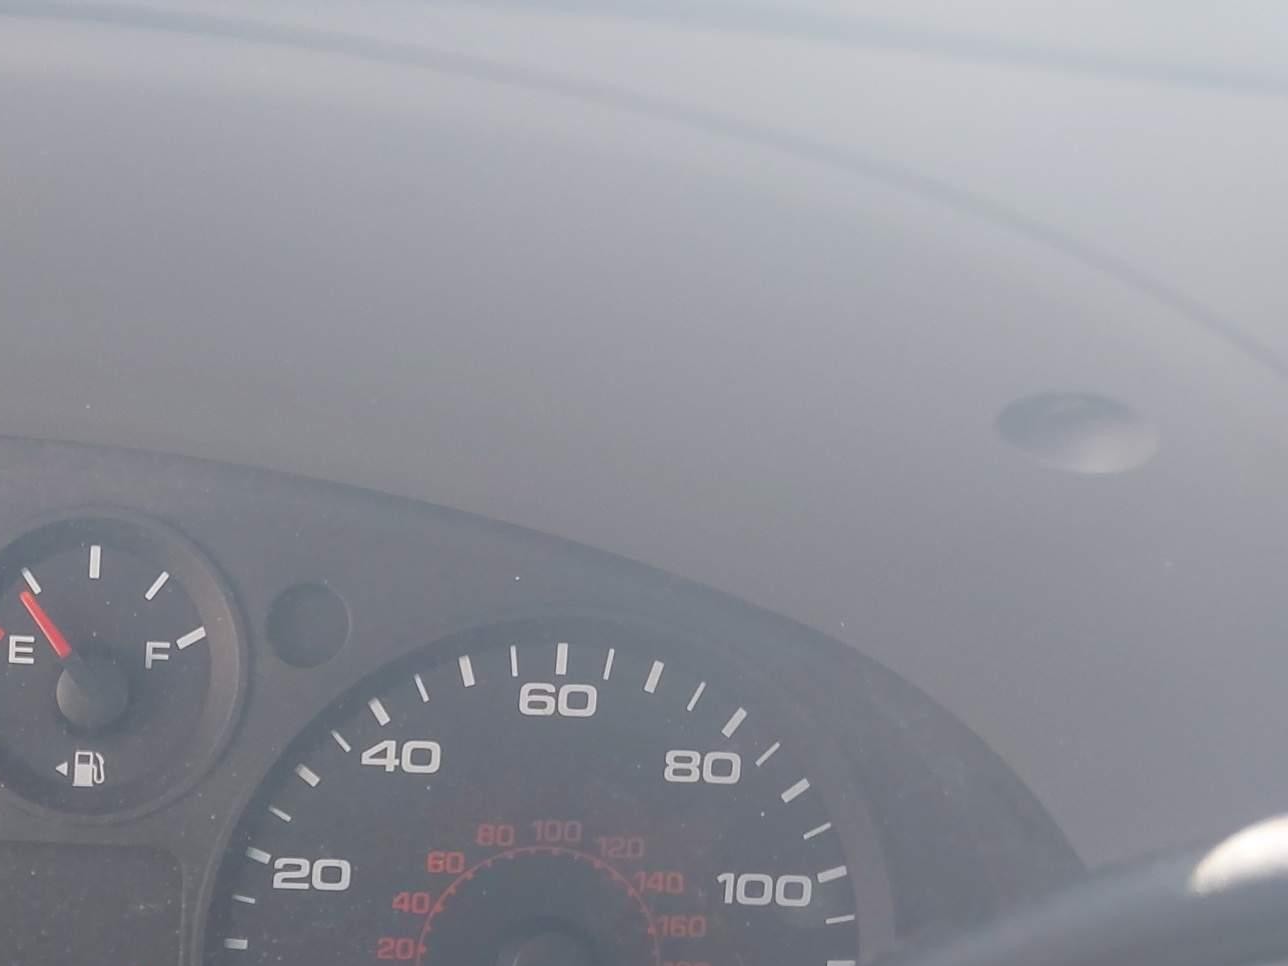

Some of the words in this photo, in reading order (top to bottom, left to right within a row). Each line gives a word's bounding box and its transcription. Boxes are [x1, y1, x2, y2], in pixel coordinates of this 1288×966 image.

[9, 636, 35, 665] E
[145, 641, 171, 669] F
[518, 682, 598, 718] 60
[360, 740, 441, 774] 40
[663, 749, 741, 785] 80
[475, 824, 515, 847] 80
[533, 820, 583, 843] 100
[597, 836, 646, 859] 120
[272, 857, 352, 892] 20
[426, 851, 465, 874] 60
[636, 871, 684, 894] 140
[716, 872, 813, 907] 100
[392, 891, 431, 915] 40
[659, 915, 707, 938] 160
[376, 938, 414, 960] 20
